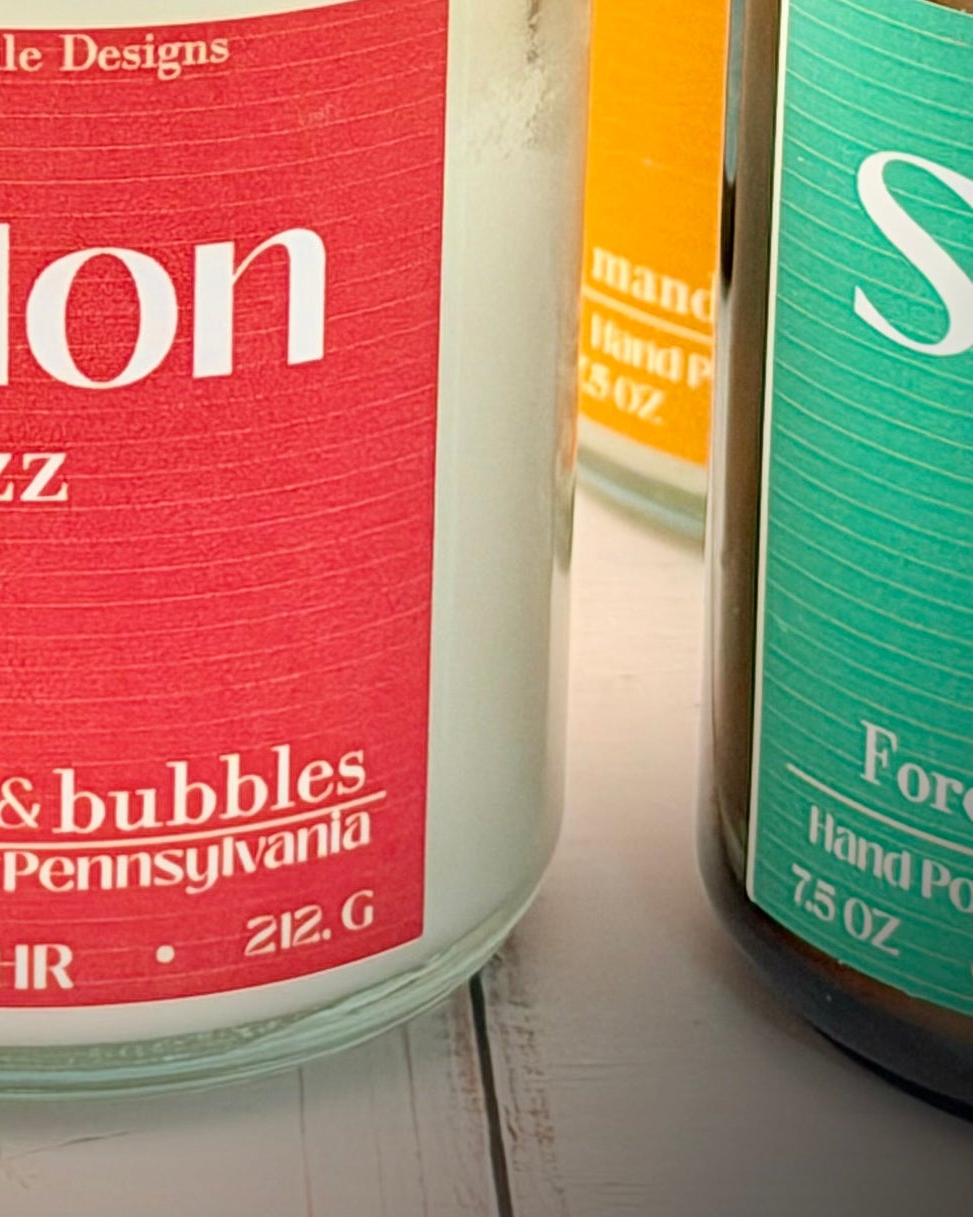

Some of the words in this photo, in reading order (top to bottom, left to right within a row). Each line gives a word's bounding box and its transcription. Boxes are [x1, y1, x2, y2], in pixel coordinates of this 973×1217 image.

[59, 32, 230, 81] Designs
[590, 312, 683, 383] Hand
[52, 744, 367, 835] bubbles
[3, 807, 372, 896] Pennsylvania
[808, 804, 912, 891] Hand
[244, 904, 333, 957] 212.
[341, 890, 375, 931] G
[791, 862, 836, 922] 7.5
[843, 896, 901, 956] OZ
